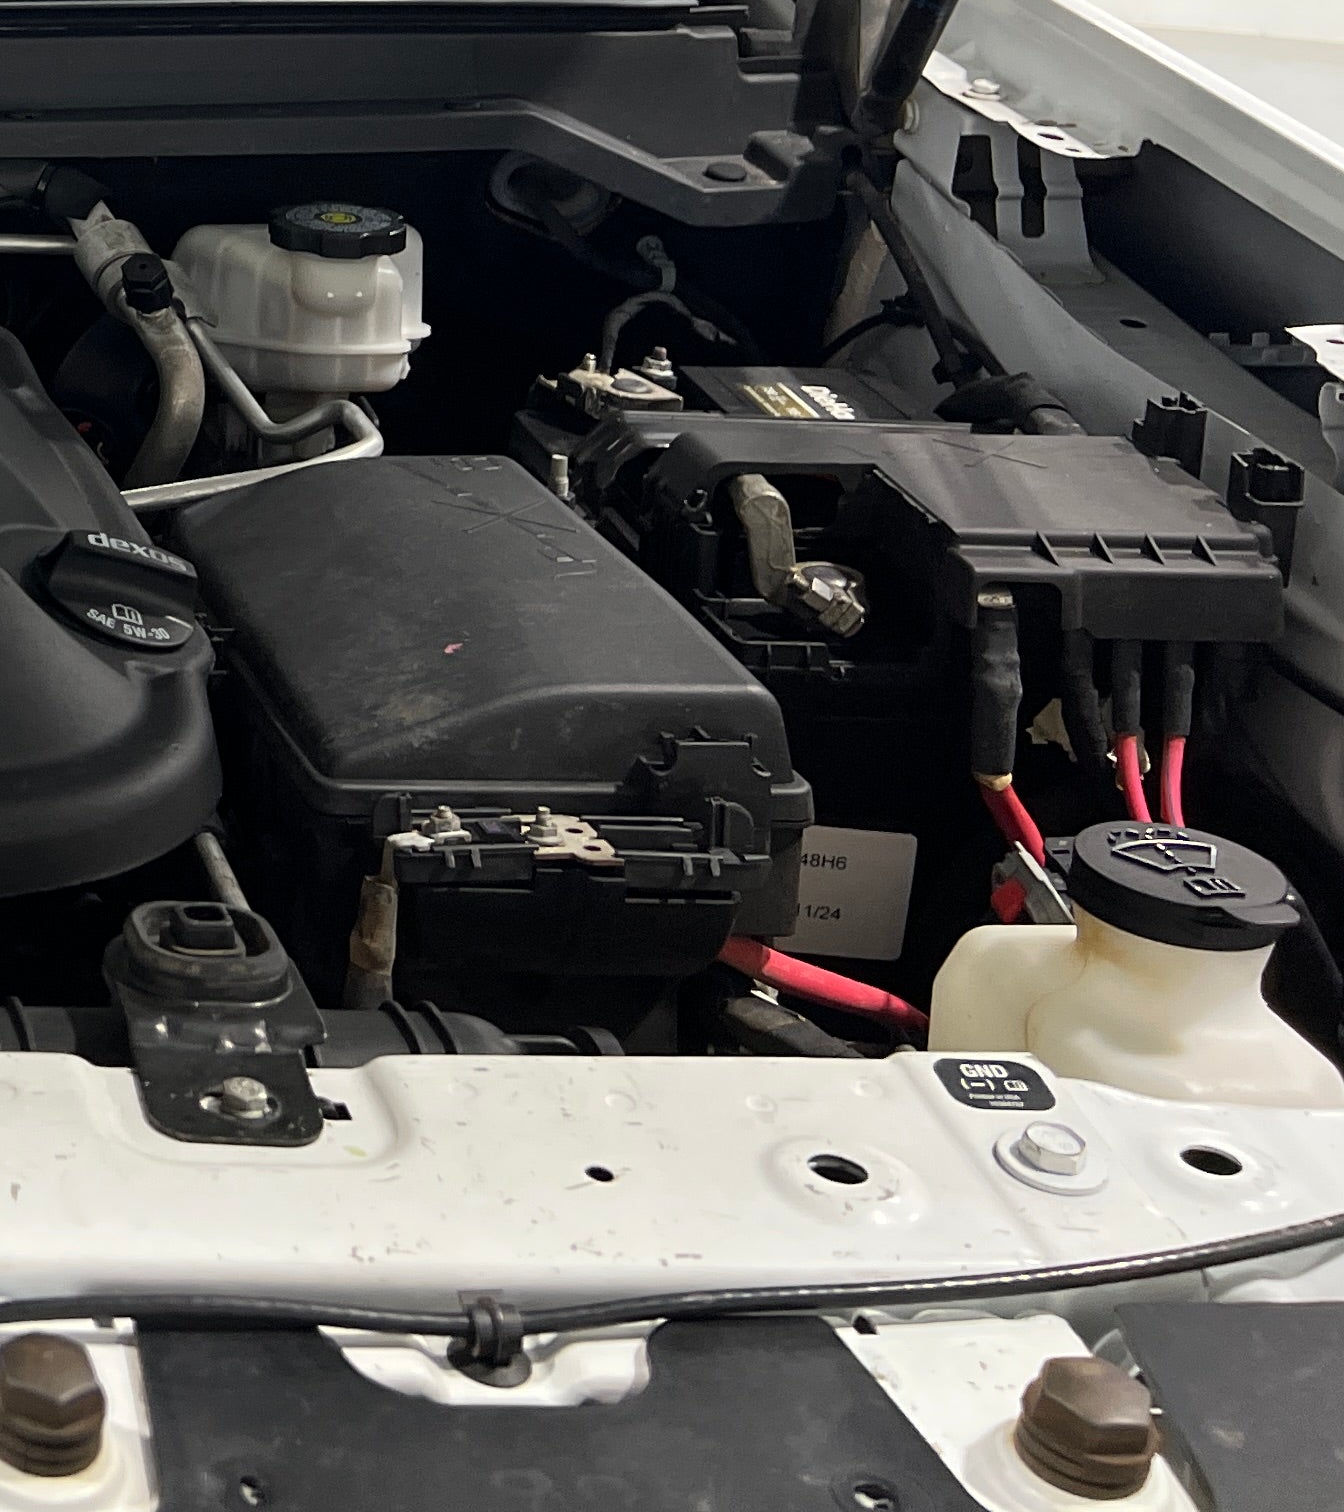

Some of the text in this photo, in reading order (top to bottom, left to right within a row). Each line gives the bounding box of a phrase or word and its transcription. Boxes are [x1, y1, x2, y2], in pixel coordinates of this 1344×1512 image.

[87, 533, 188, 572] dexos
[87, 608, 171, 640] SAE 5W-30
[959, 1063, 1009, 1078] GND
